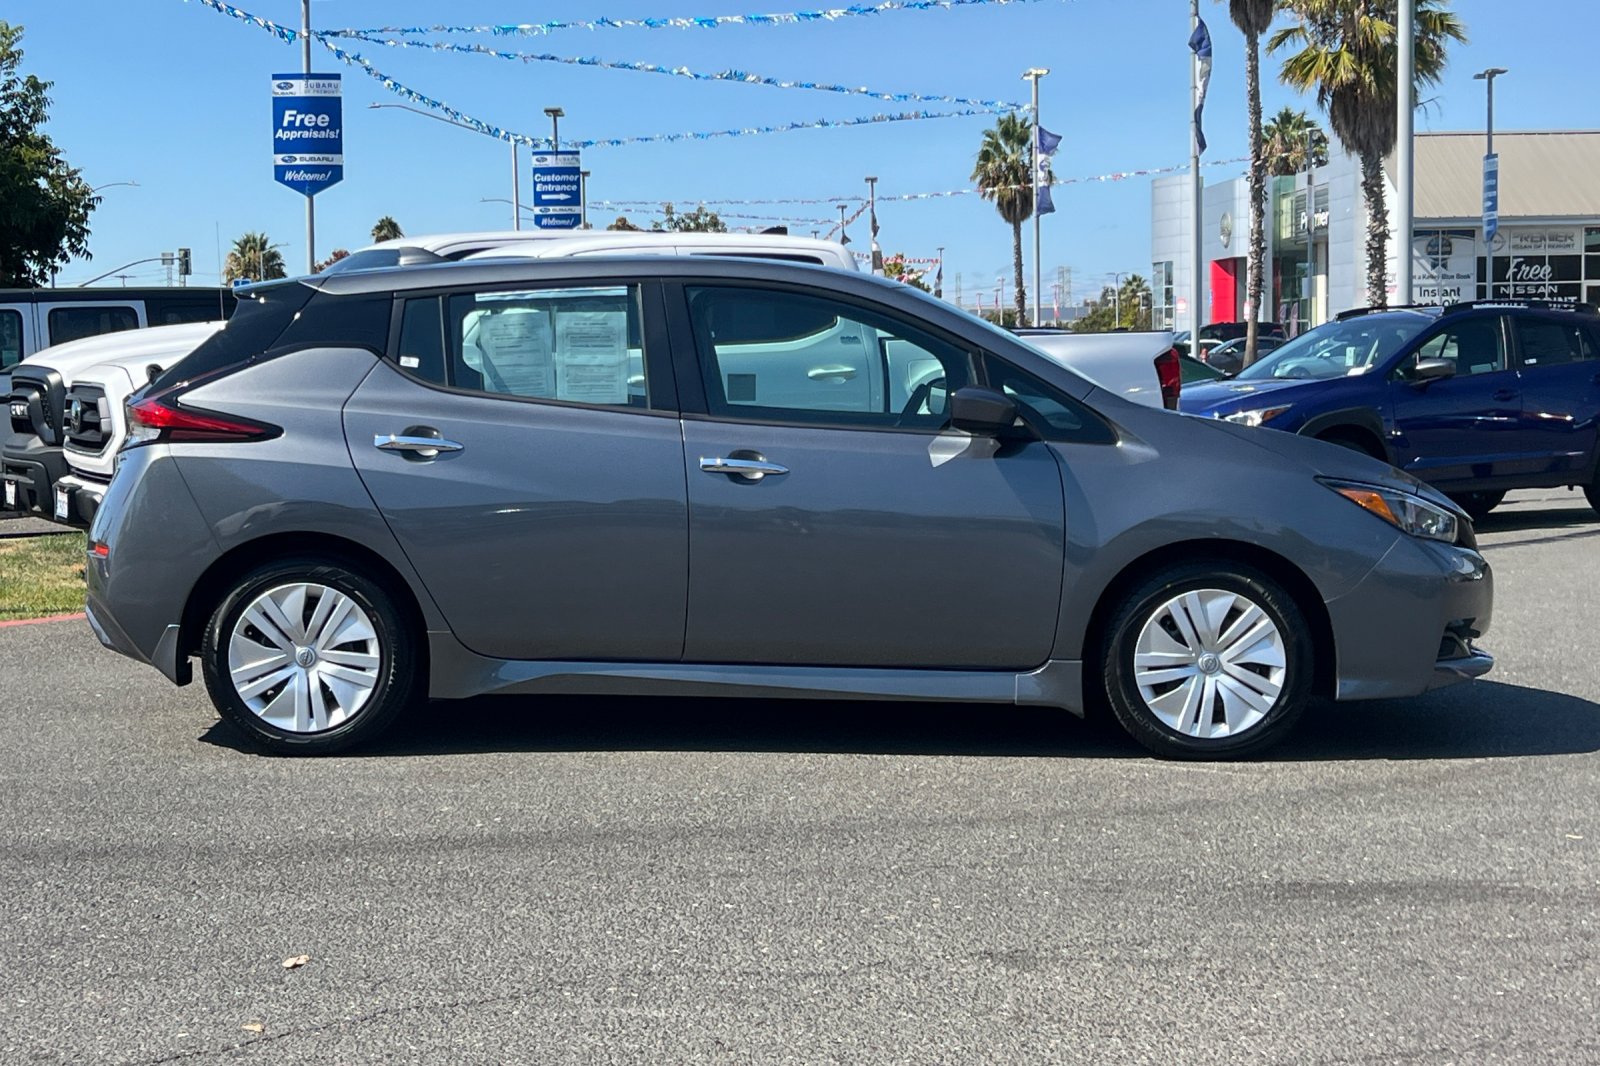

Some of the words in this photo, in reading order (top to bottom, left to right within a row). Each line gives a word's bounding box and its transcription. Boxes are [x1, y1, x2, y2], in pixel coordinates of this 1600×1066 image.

[283, 110, 330, 127] Free
[275, 129, 339, 140] Appraisals!
[284, 170, 331, 181] Welcome!
[534, 174, 579, 182] Customer
[536, 183, 577, 192] Entrance
[1300, 208, 1329, 230] Prmier
[1505, 258, 1553, 280] Free
[1500, 285, 1558, 294] NISSAN
